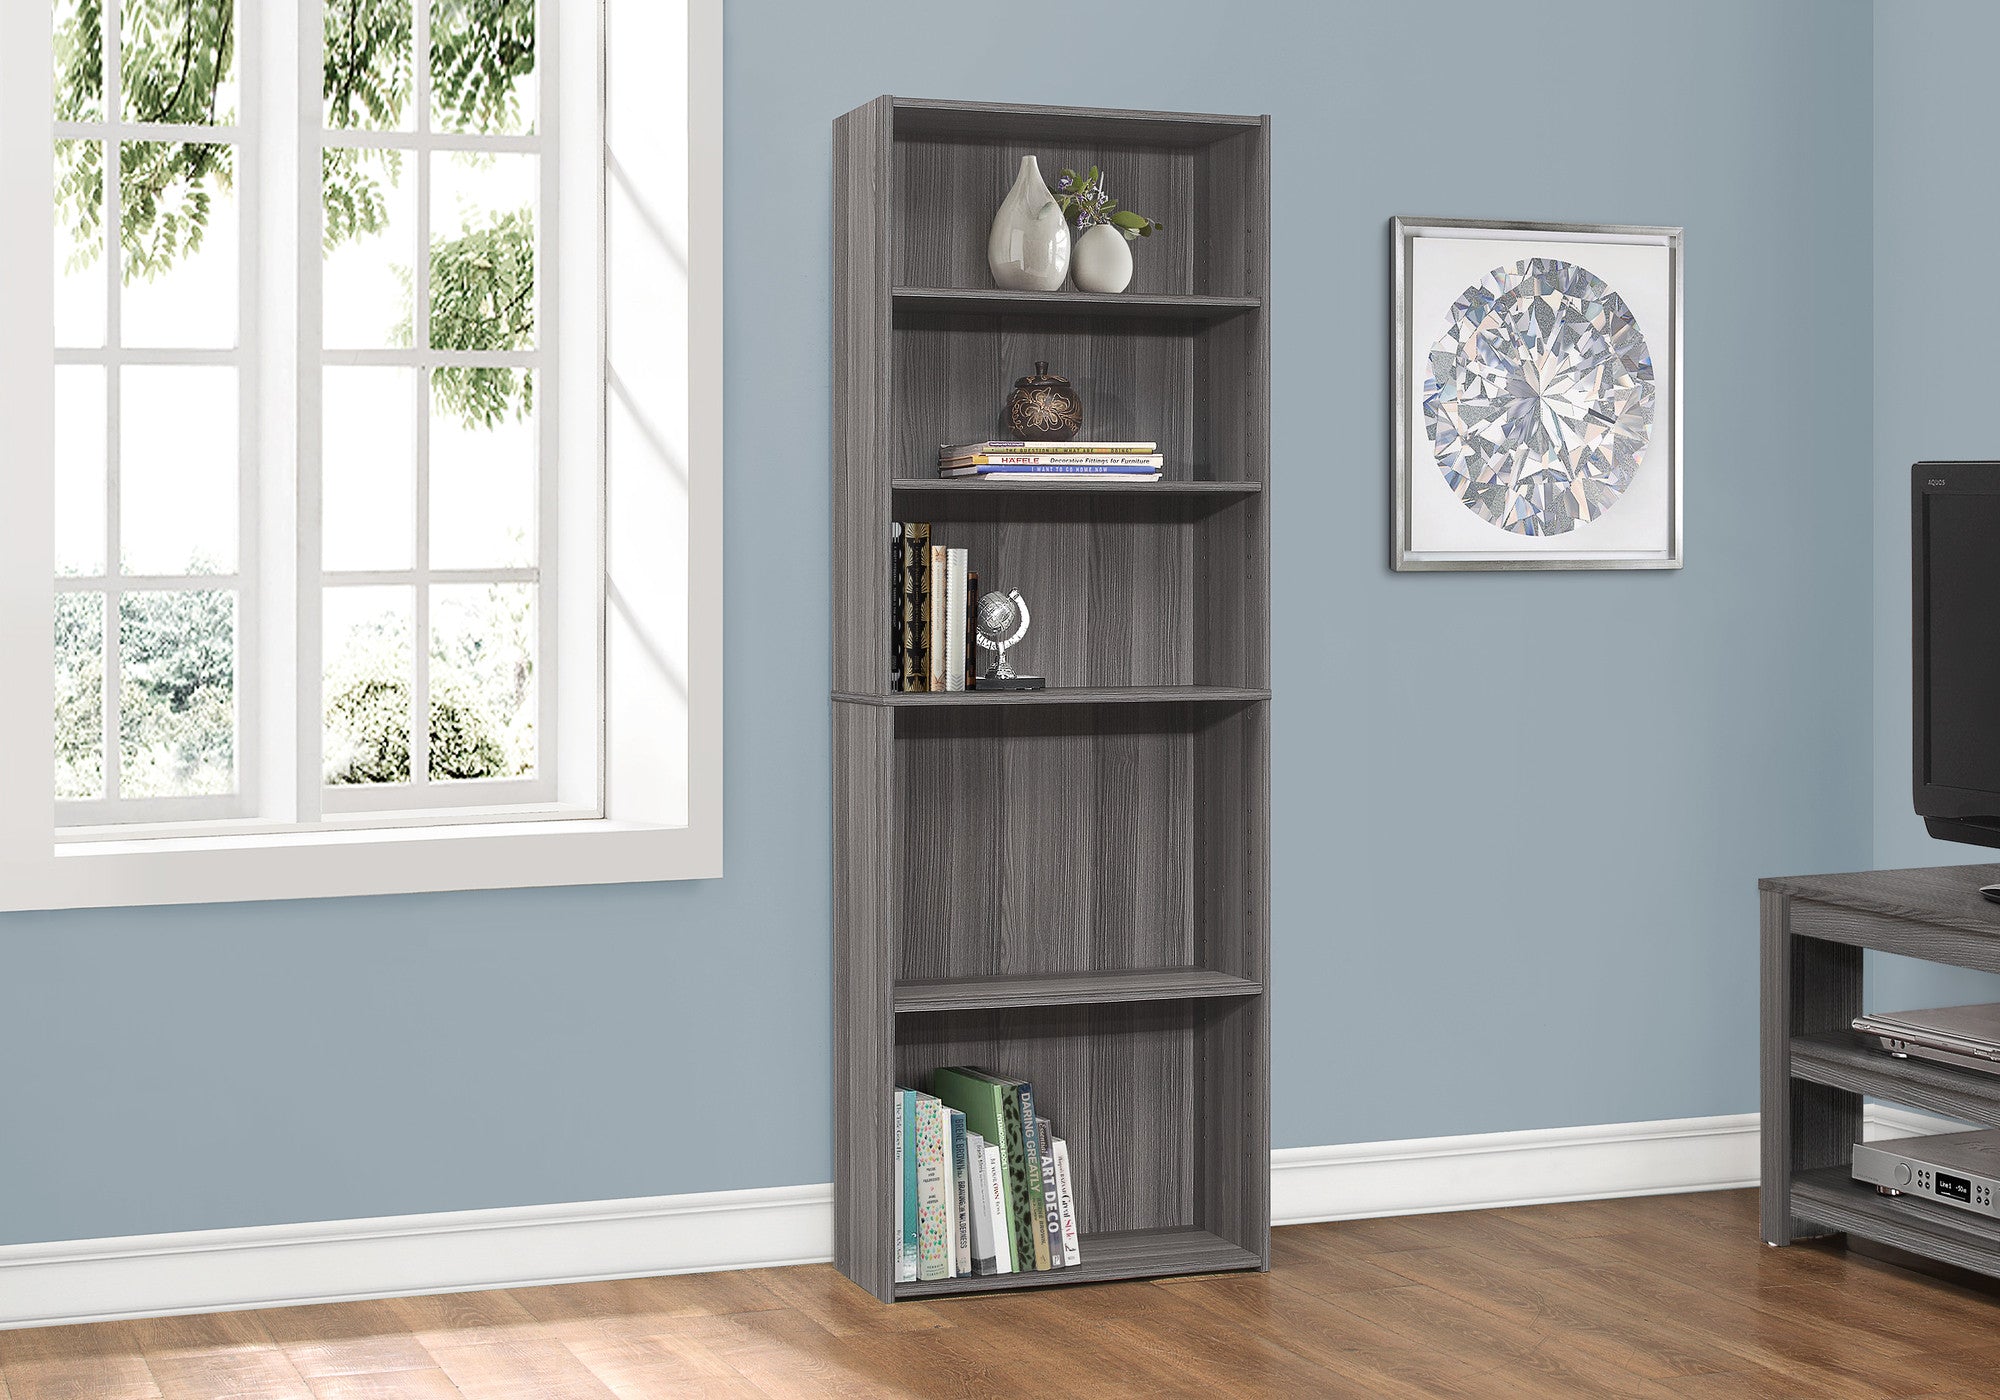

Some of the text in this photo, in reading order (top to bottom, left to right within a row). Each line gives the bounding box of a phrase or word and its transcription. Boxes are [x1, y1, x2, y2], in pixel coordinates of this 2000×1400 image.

[956, 1143, 966, 1170] BROWN
[1021, 1092, 1040, 1192] DARING GREATLY
[1039, 1123, 1059, 1233] Essential ART DECO
[960, 1213, 968, 1249] WILDERNESS
